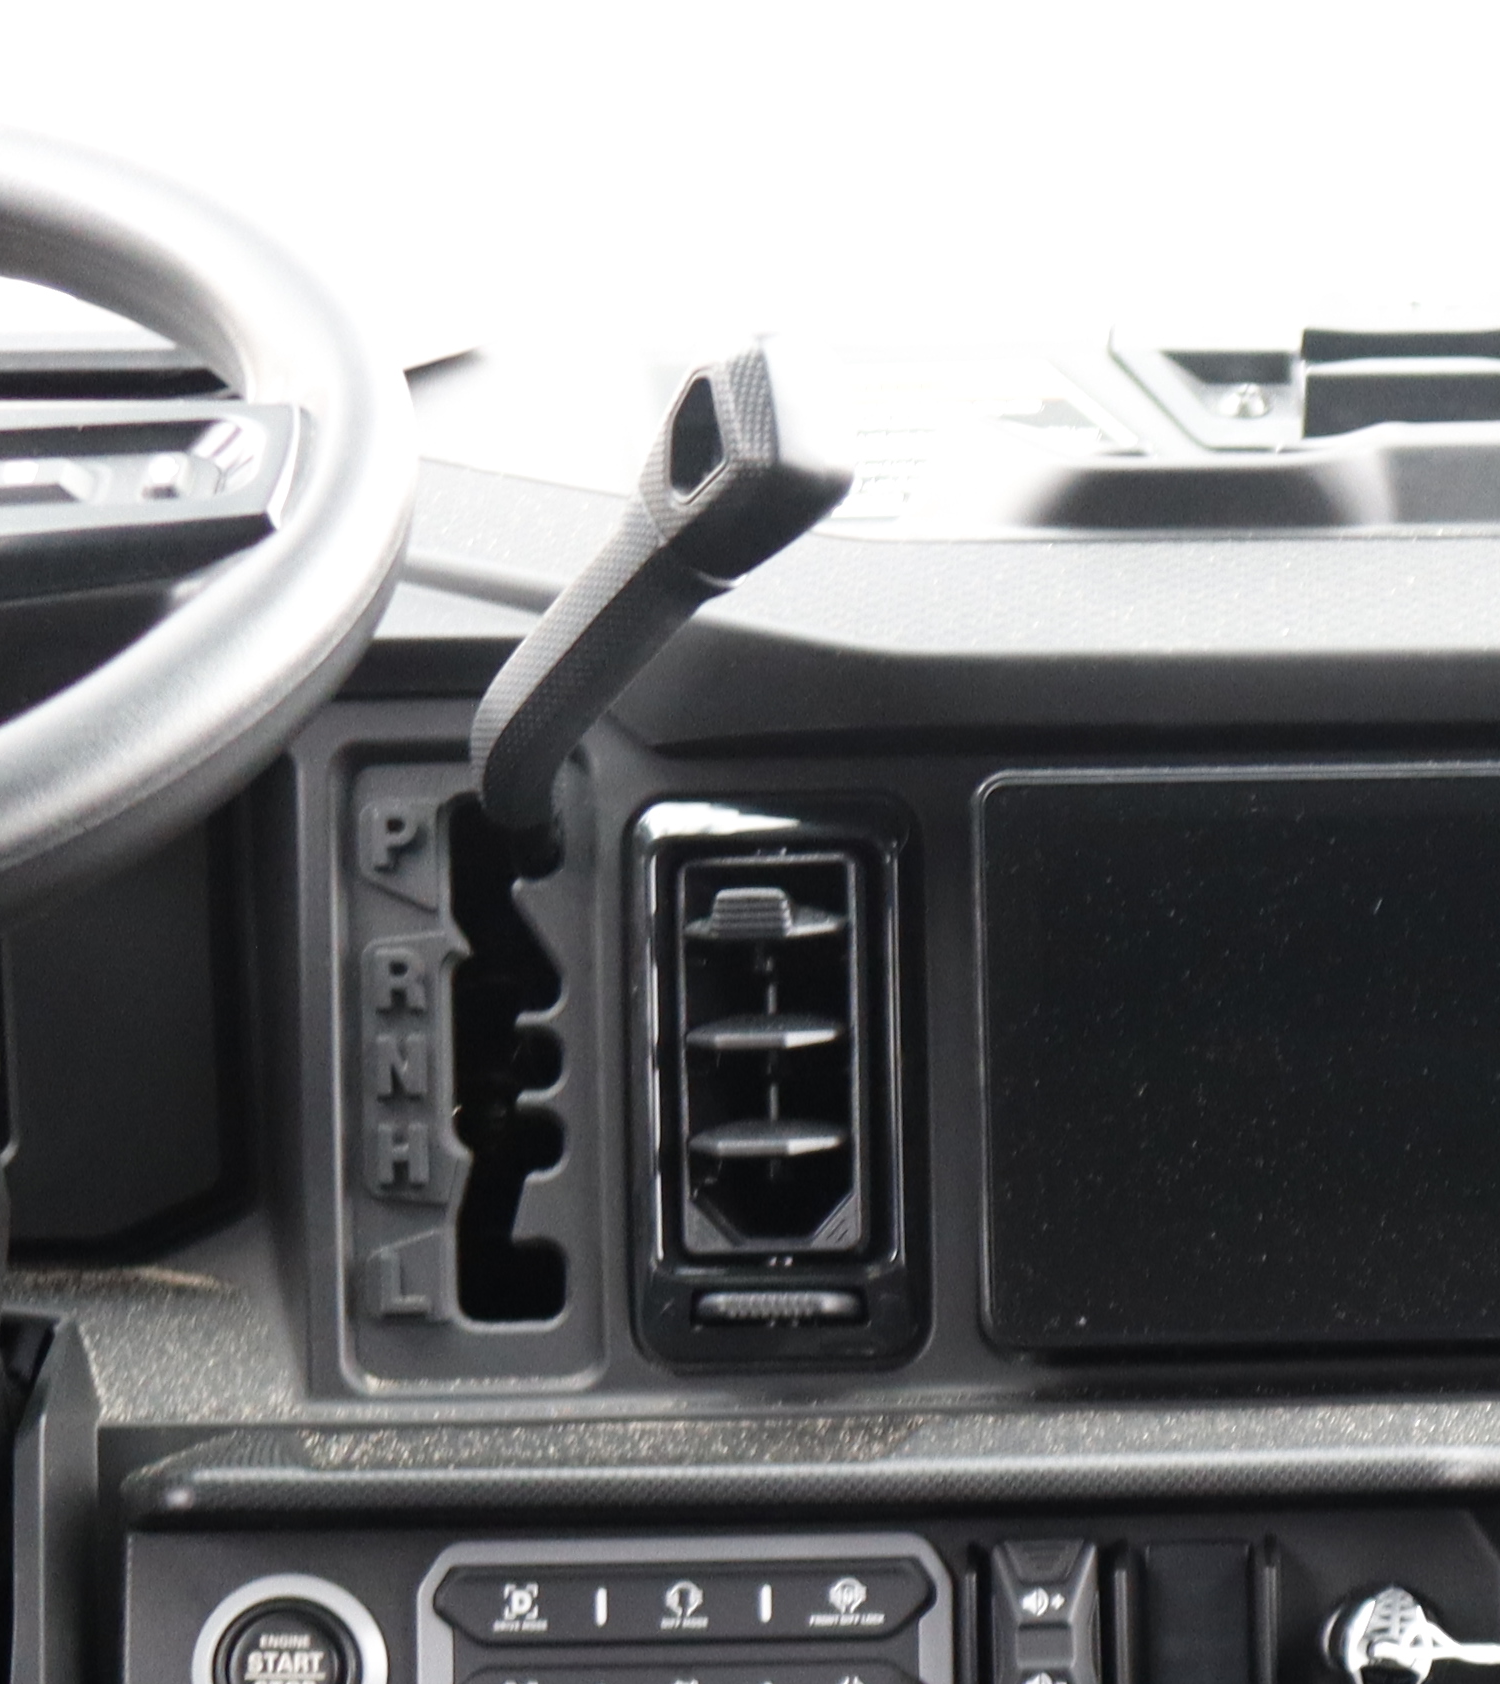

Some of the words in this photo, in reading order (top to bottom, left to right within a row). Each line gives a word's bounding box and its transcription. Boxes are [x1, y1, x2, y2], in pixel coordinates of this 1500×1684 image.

[373, 815, 418, 873] P
[372, 948, 428, 1014] R
[373, 1032, 429, 1100] N
[373, 1120, 431, 1188] H
[247, 1651, 325, 1673] START
[259, 1634, 312, 1649] ENGINE
